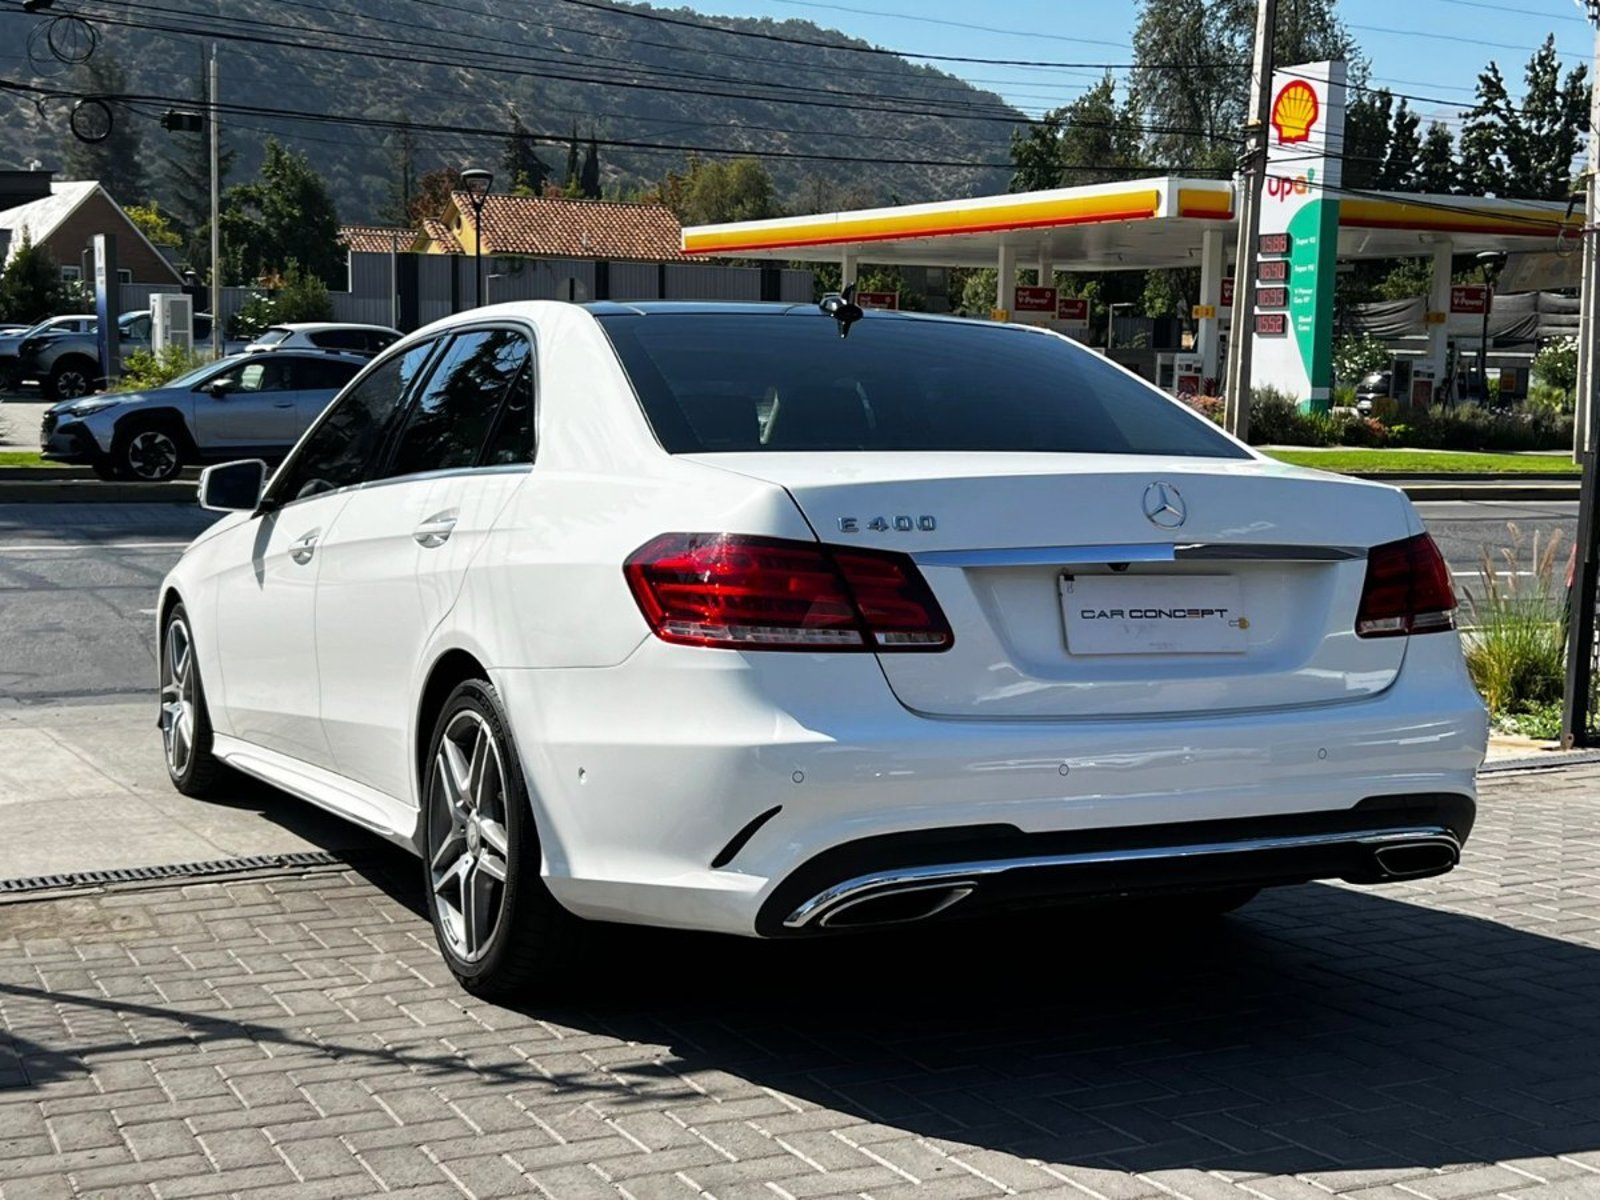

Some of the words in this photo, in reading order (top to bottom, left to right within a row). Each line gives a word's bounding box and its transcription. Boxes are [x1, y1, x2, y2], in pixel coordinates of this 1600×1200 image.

[837, 517, 860, 533] E
[866, 515, 937, 532] 400
[1081, 609, 1125, 619] CAR
[1129, 608, 1228, 619] CONCEPT
